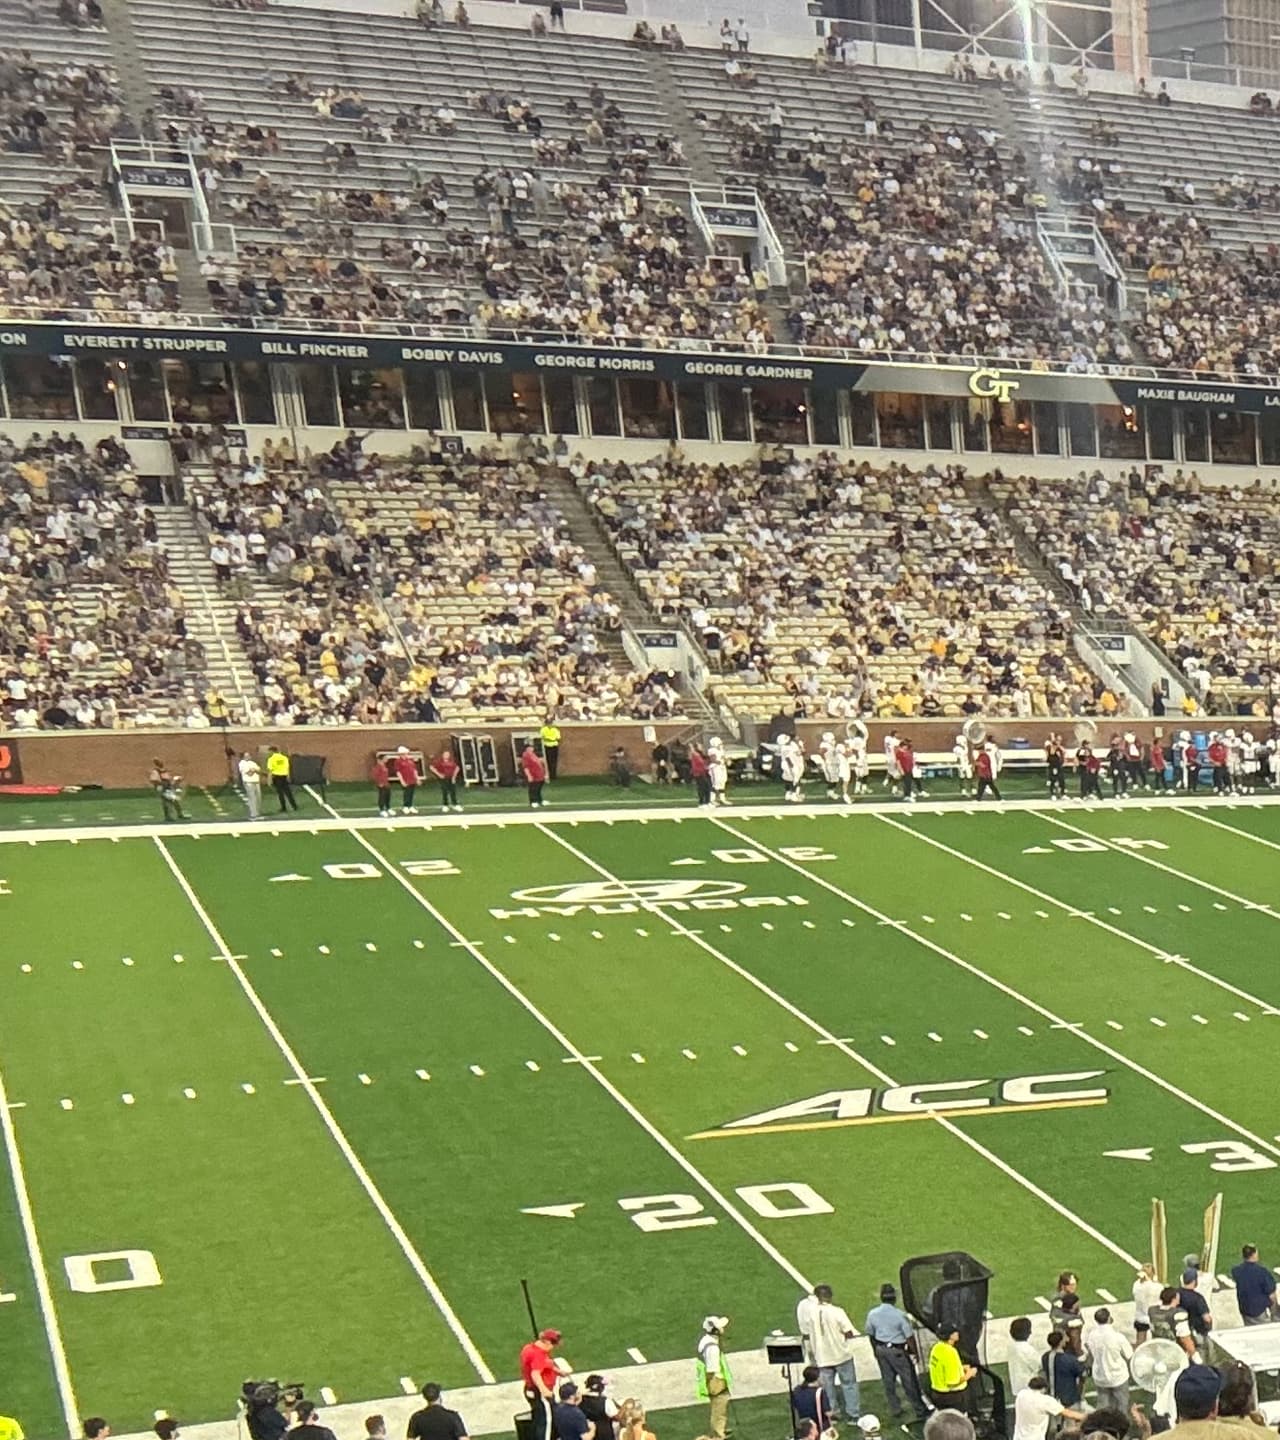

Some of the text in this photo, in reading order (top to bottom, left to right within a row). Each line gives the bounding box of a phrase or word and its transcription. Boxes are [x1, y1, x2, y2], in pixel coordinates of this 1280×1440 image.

[64, 334, 228, 352] EVERETT STRUPPER
[261, 341, 369, 358] BILL FINCHER
[402, 347, 504, 365] BOBBY DAVIS
[534, 354, 656, 371] GEORGE MORRIS
[685, 362, 813, 380] GEORGE GARDNER
[967, 368, 1019, 402] GT
[1137, 387, 1236, 404] MAXIE BAUGHAN
[711, 845, 838, 864] 30
[322, 858, 462, 879] 20
[488, 894, 810, 920] HYUNDAI
[700, 1069, 1116, 1132] ACC
[616, 1181, 836, 1233] 20
